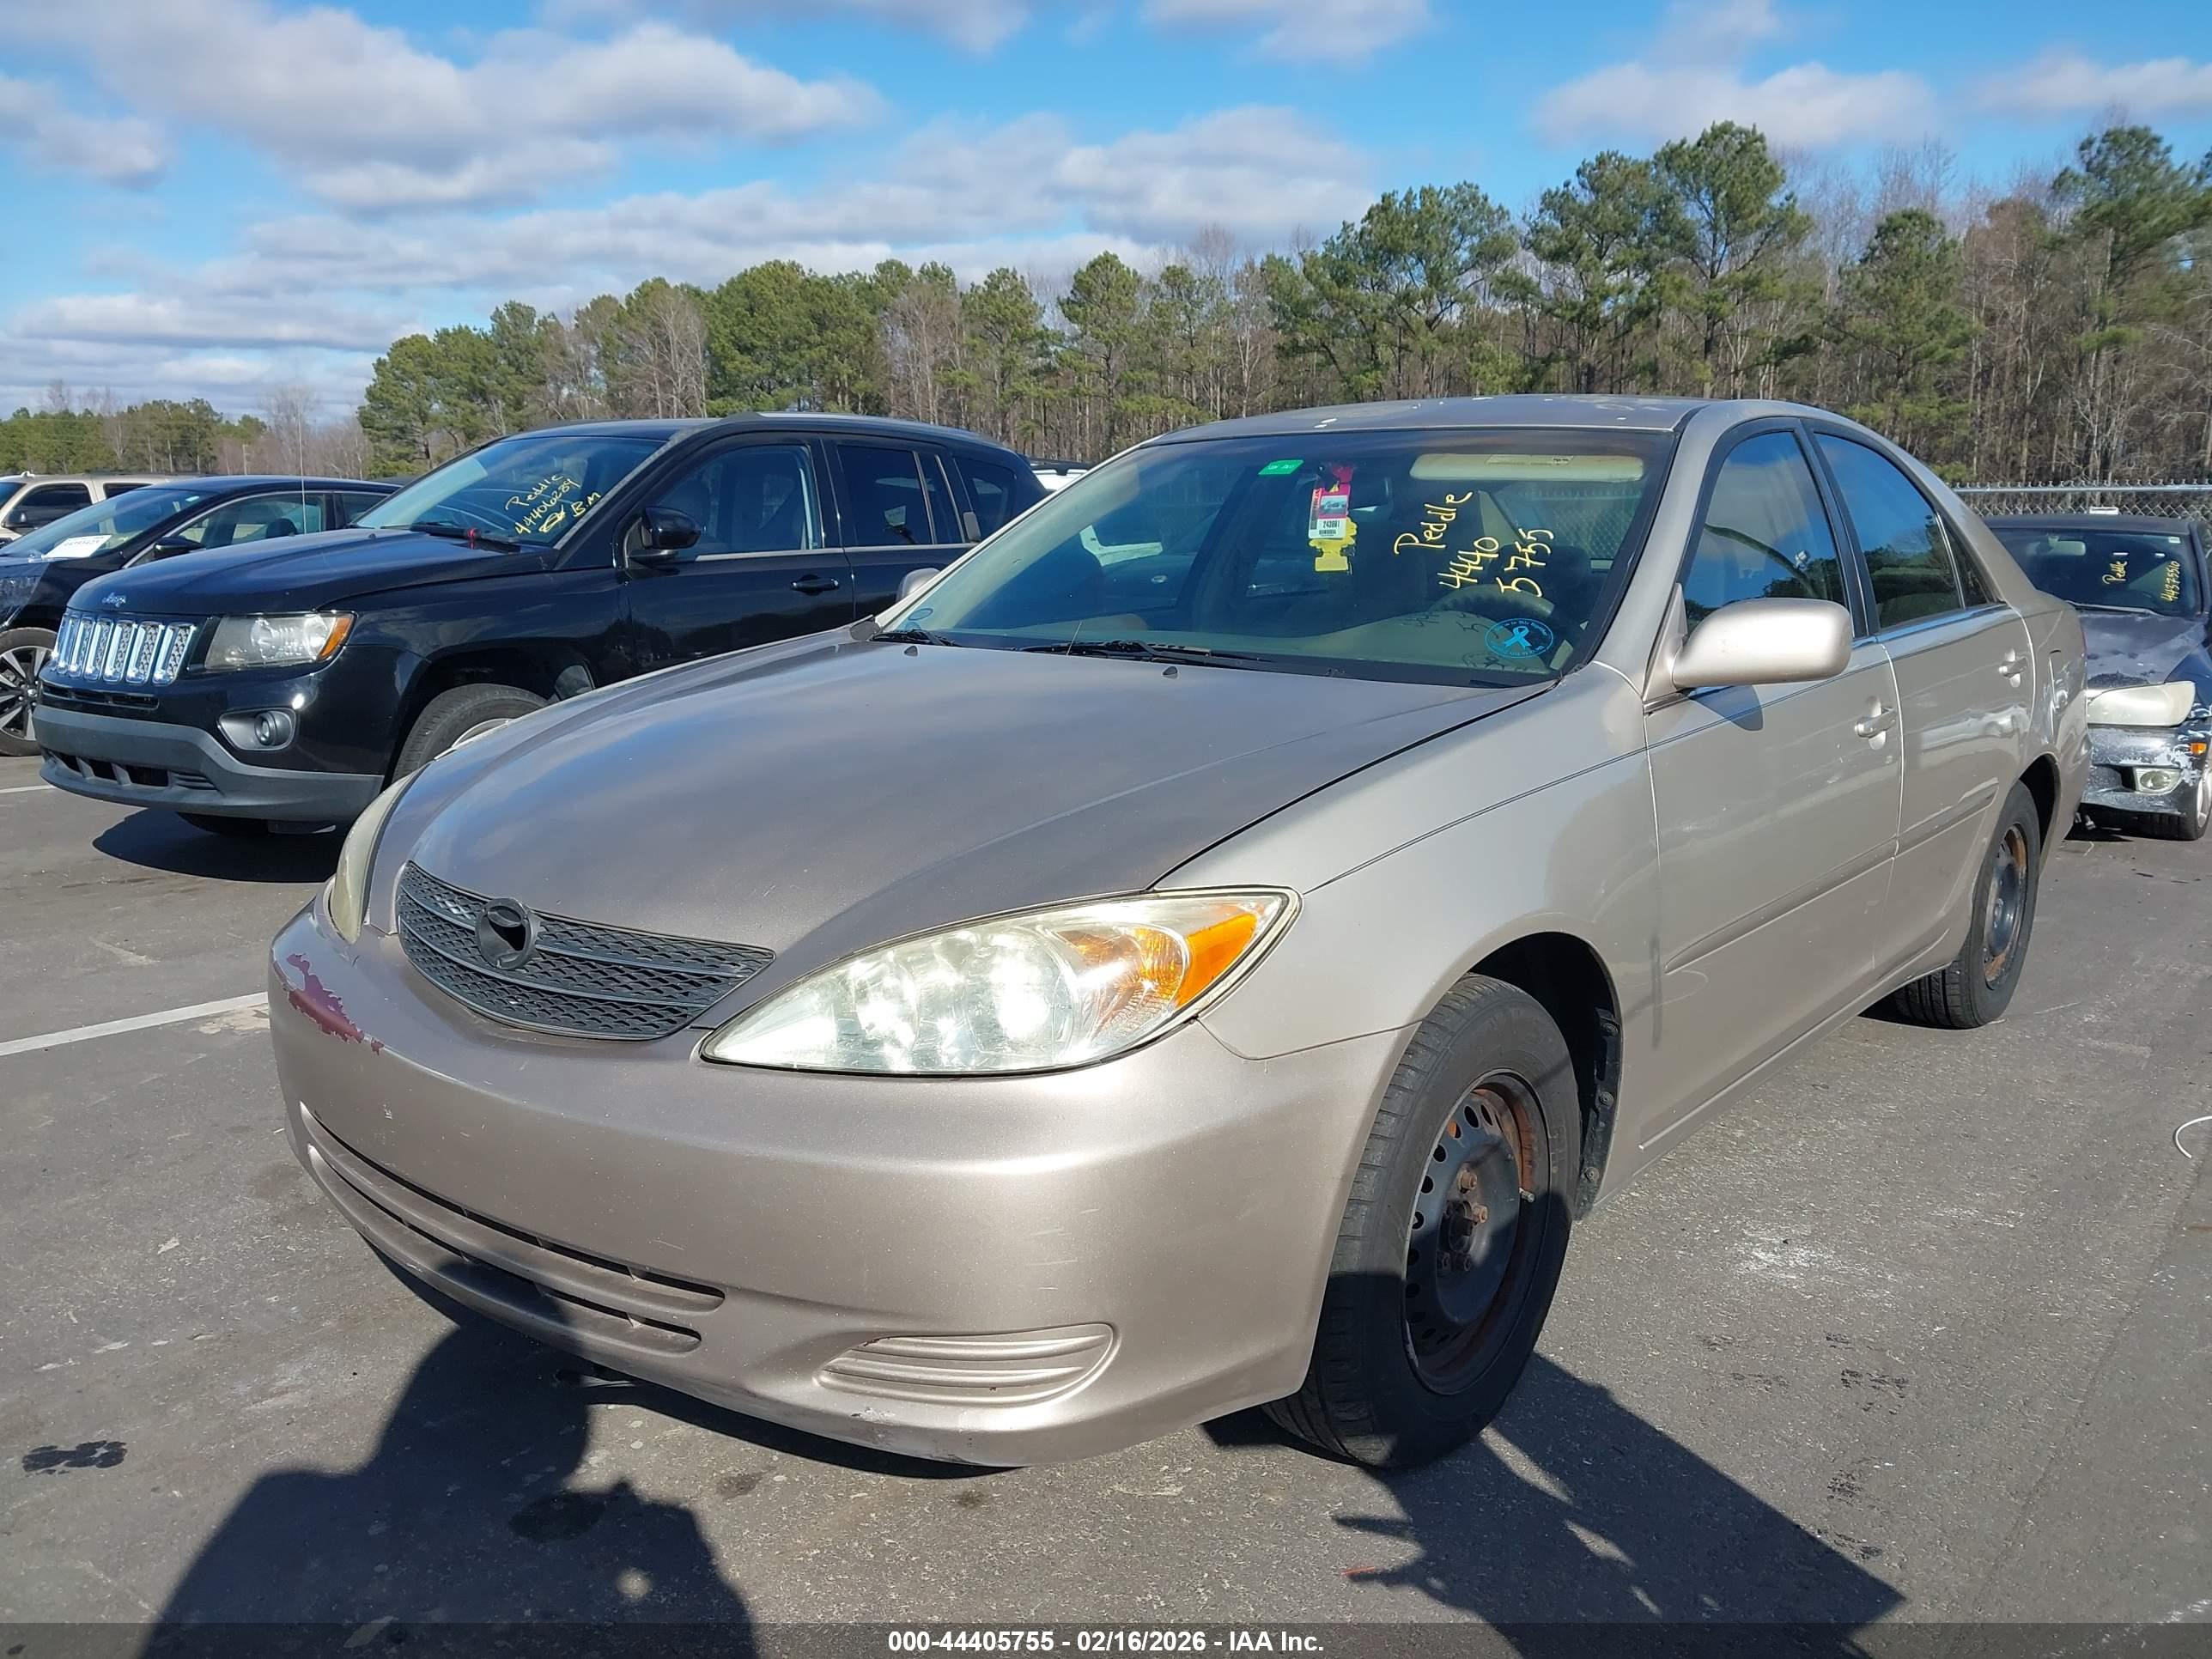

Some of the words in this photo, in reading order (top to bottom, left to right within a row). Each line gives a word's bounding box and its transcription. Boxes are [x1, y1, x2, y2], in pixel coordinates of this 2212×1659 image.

[1394, 491, 1473, 554] Peddle
[1437, 537, 1499, 589] 4440
[1496, 528, 1554, 598] 5755
